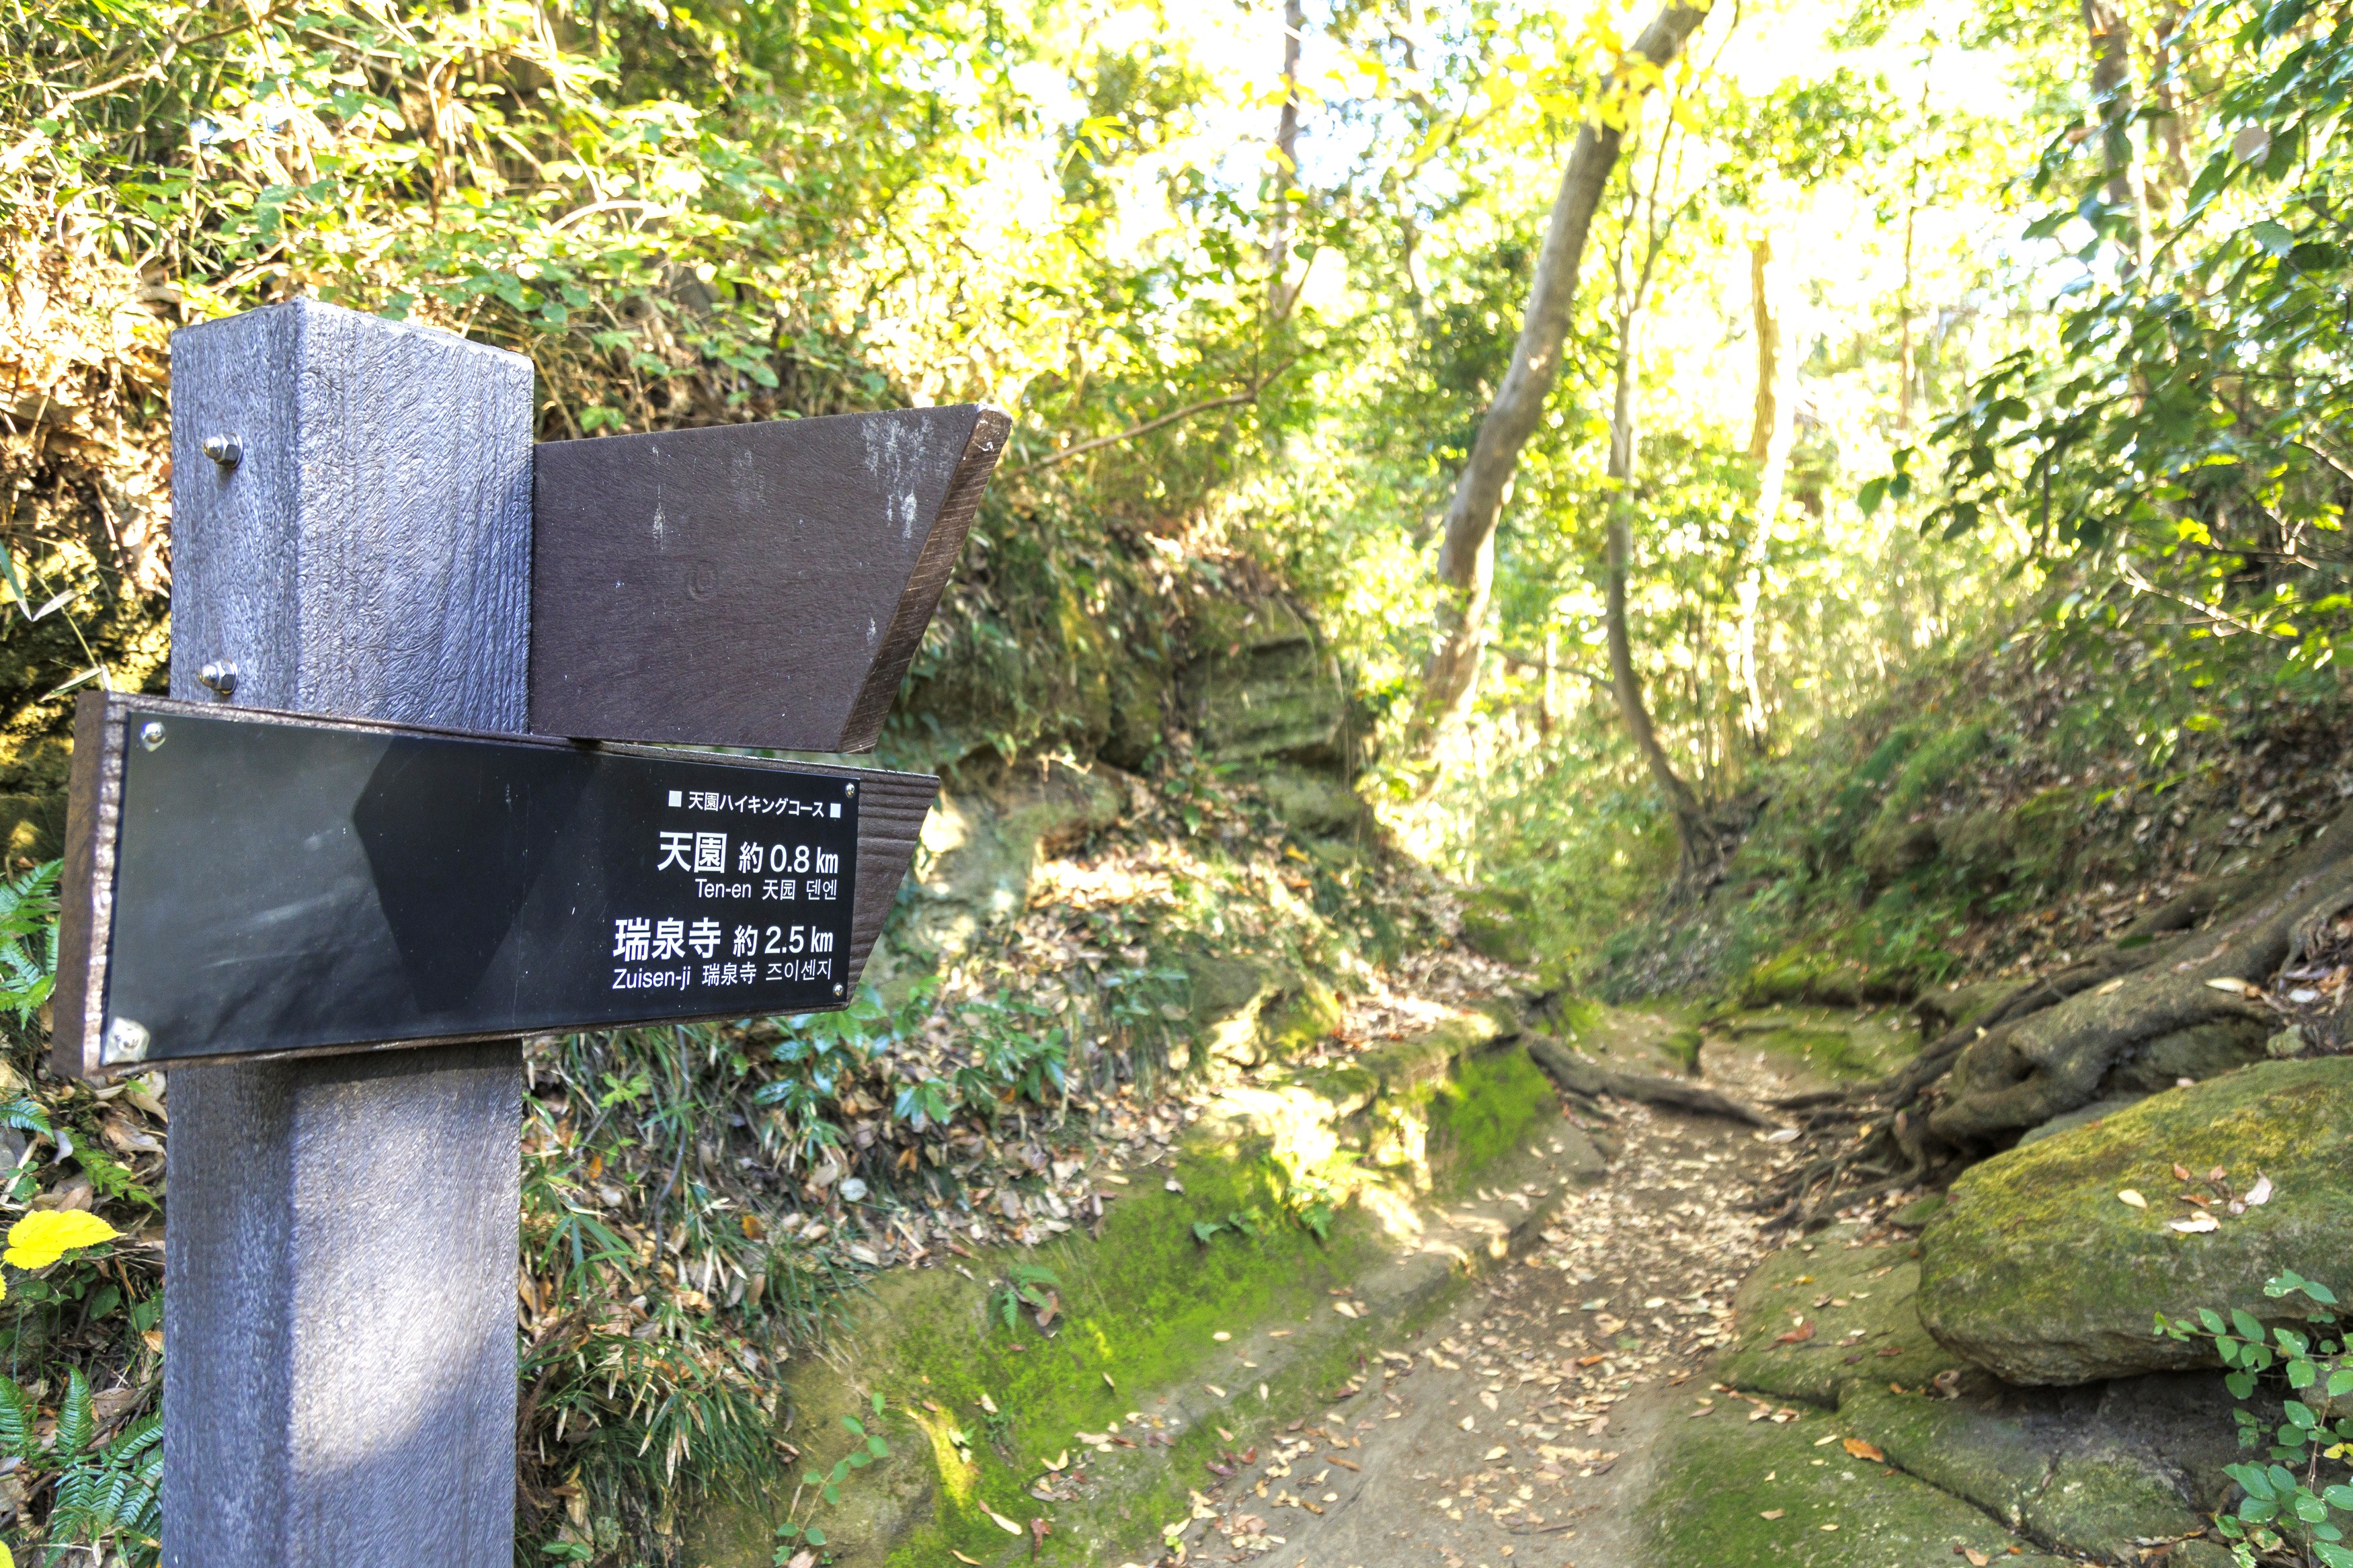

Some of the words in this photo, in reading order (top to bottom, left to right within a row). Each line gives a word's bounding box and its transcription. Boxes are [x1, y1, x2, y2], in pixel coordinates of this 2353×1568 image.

[688, 792, 824, 817] 天園ハイキングコース
[657, 831, 727, 873] 天園
[739, 841, 763, 873] 約
[695, 878, 751, 898] Ten-en
[762, 880, 795, 900] 天园
[807, 879, 836, 900] 덴엔
[613, 917, 721, 962] 瑞泉寺
[733, 925, 758, 957] 約
[612, 966, 690, 991] Zuisen-ji
[702, 962, 756, 986] 瑞泉寺
[766, 958, 831, 981] 즈이센지
